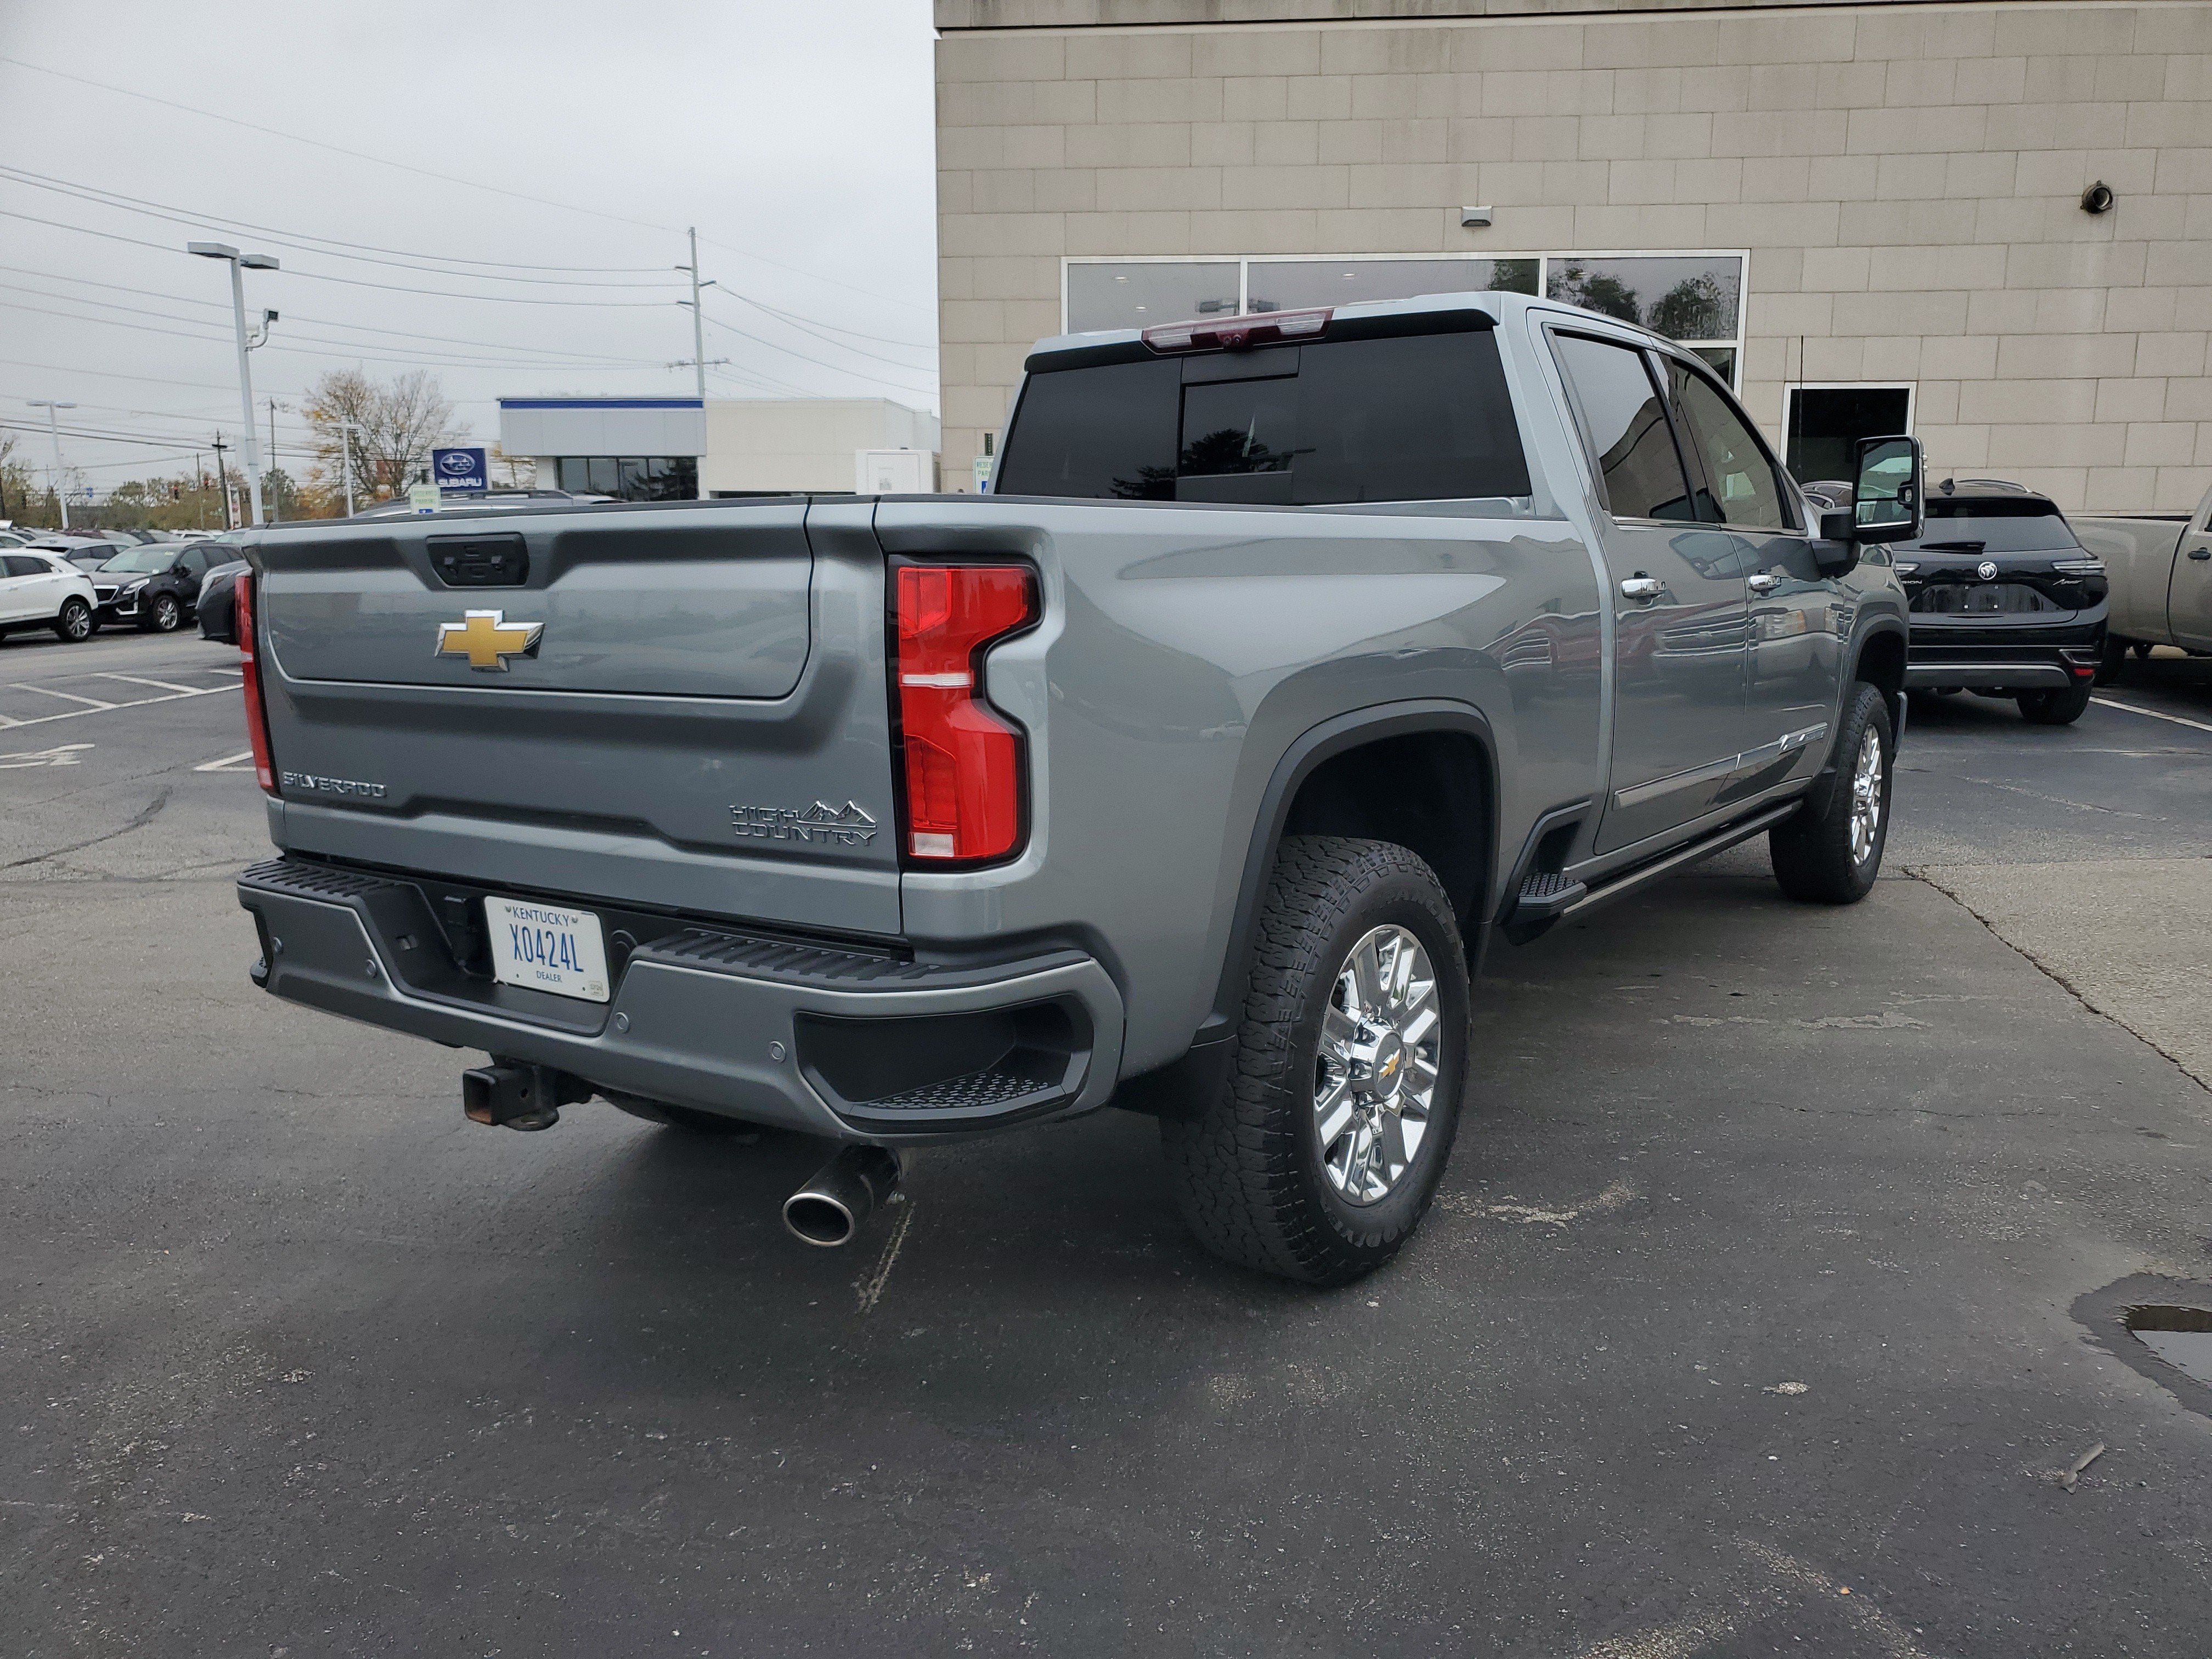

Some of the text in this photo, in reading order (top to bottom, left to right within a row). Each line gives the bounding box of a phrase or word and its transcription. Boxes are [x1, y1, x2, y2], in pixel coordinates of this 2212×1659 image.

[437, 477, 483, 488] SUBARU
[283, 771, 387, 797] SILVERADO
[729, 805, 799, 821] HIGH
[732, 821, 877, 845] COUNTRY
[512, 906, 571, 927] KENTUCKY
[509, 923, 584, 973] X0424L
[536, 970, 562, 983] DEALER
